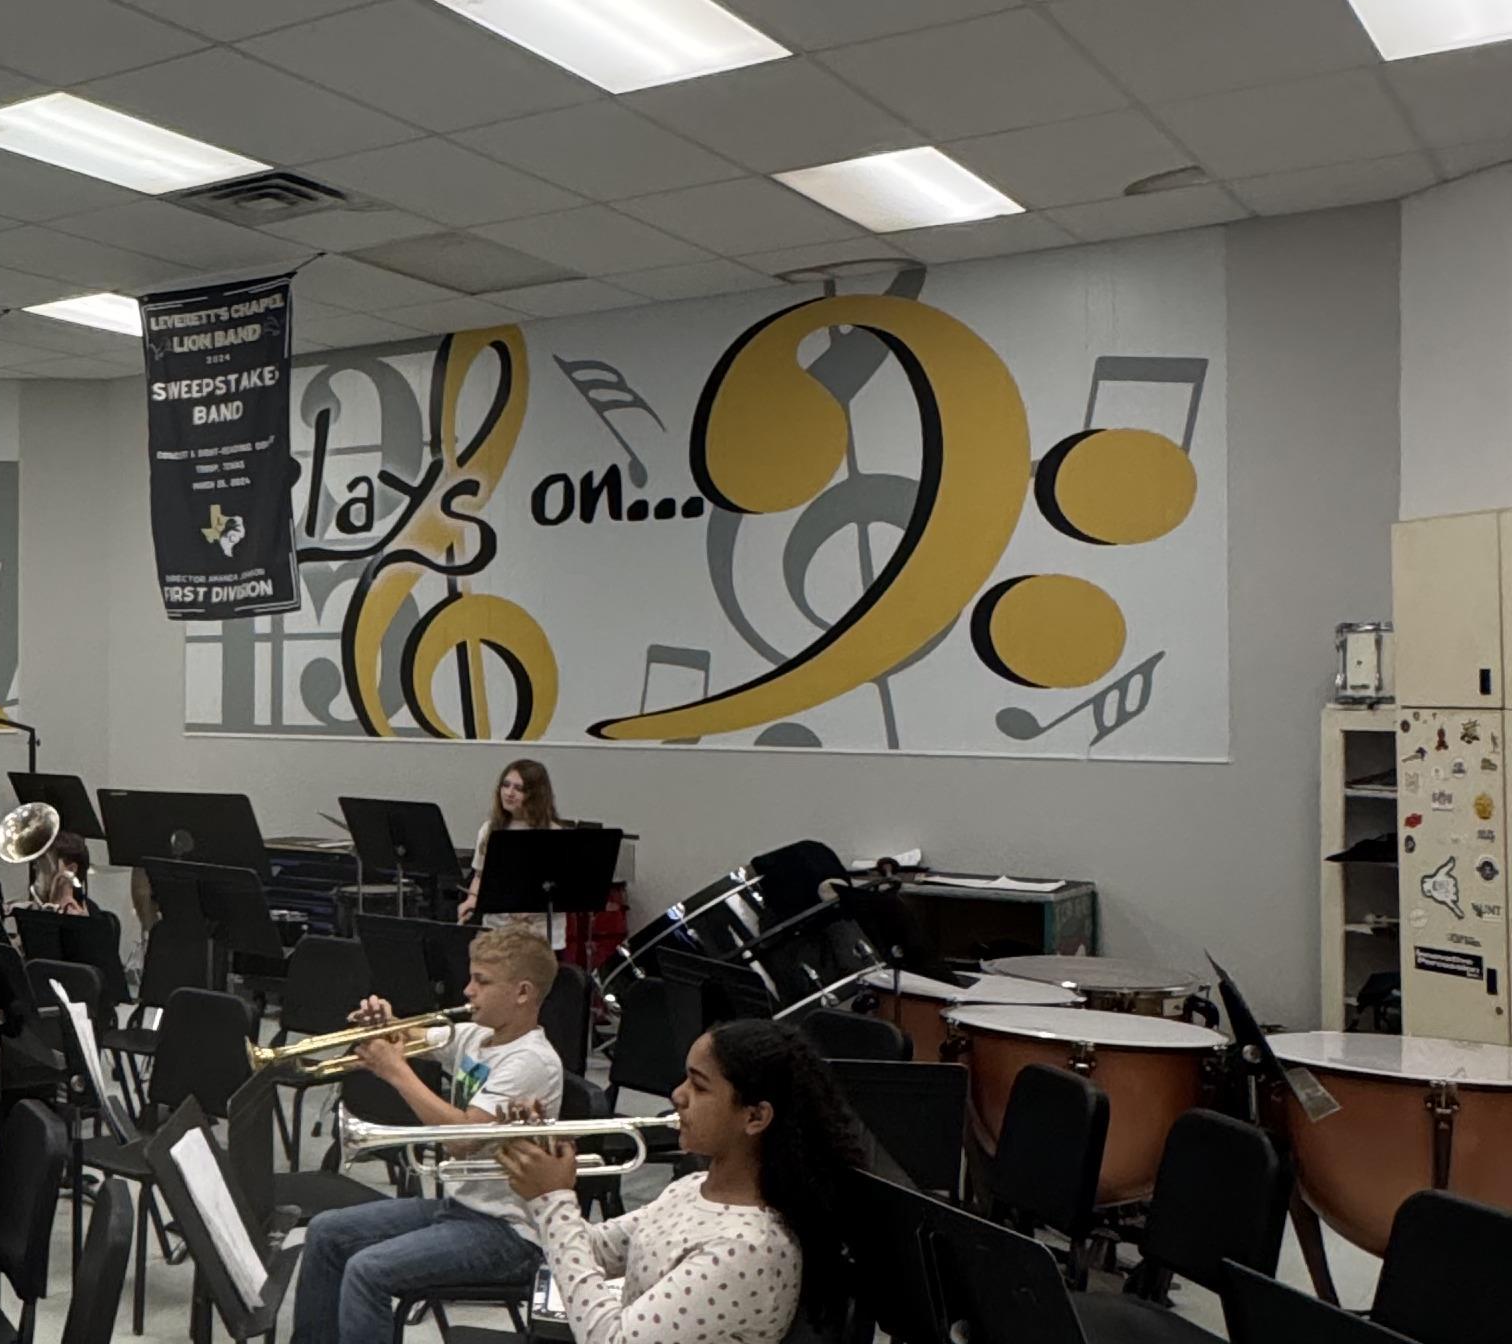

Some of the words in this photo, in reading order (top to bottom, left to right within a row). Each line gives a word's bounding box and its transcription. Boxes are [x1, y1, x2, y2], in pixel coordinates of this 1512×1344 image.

[230, 293, 285, 318] CHAPEL
[172, 332, 212, 353] LION
[215, 324, 262, 345] BAND
[192, 400, 244, 425] BAND
[290, 408, 497, 576] lays
[531, 463, 705, 526] on...
